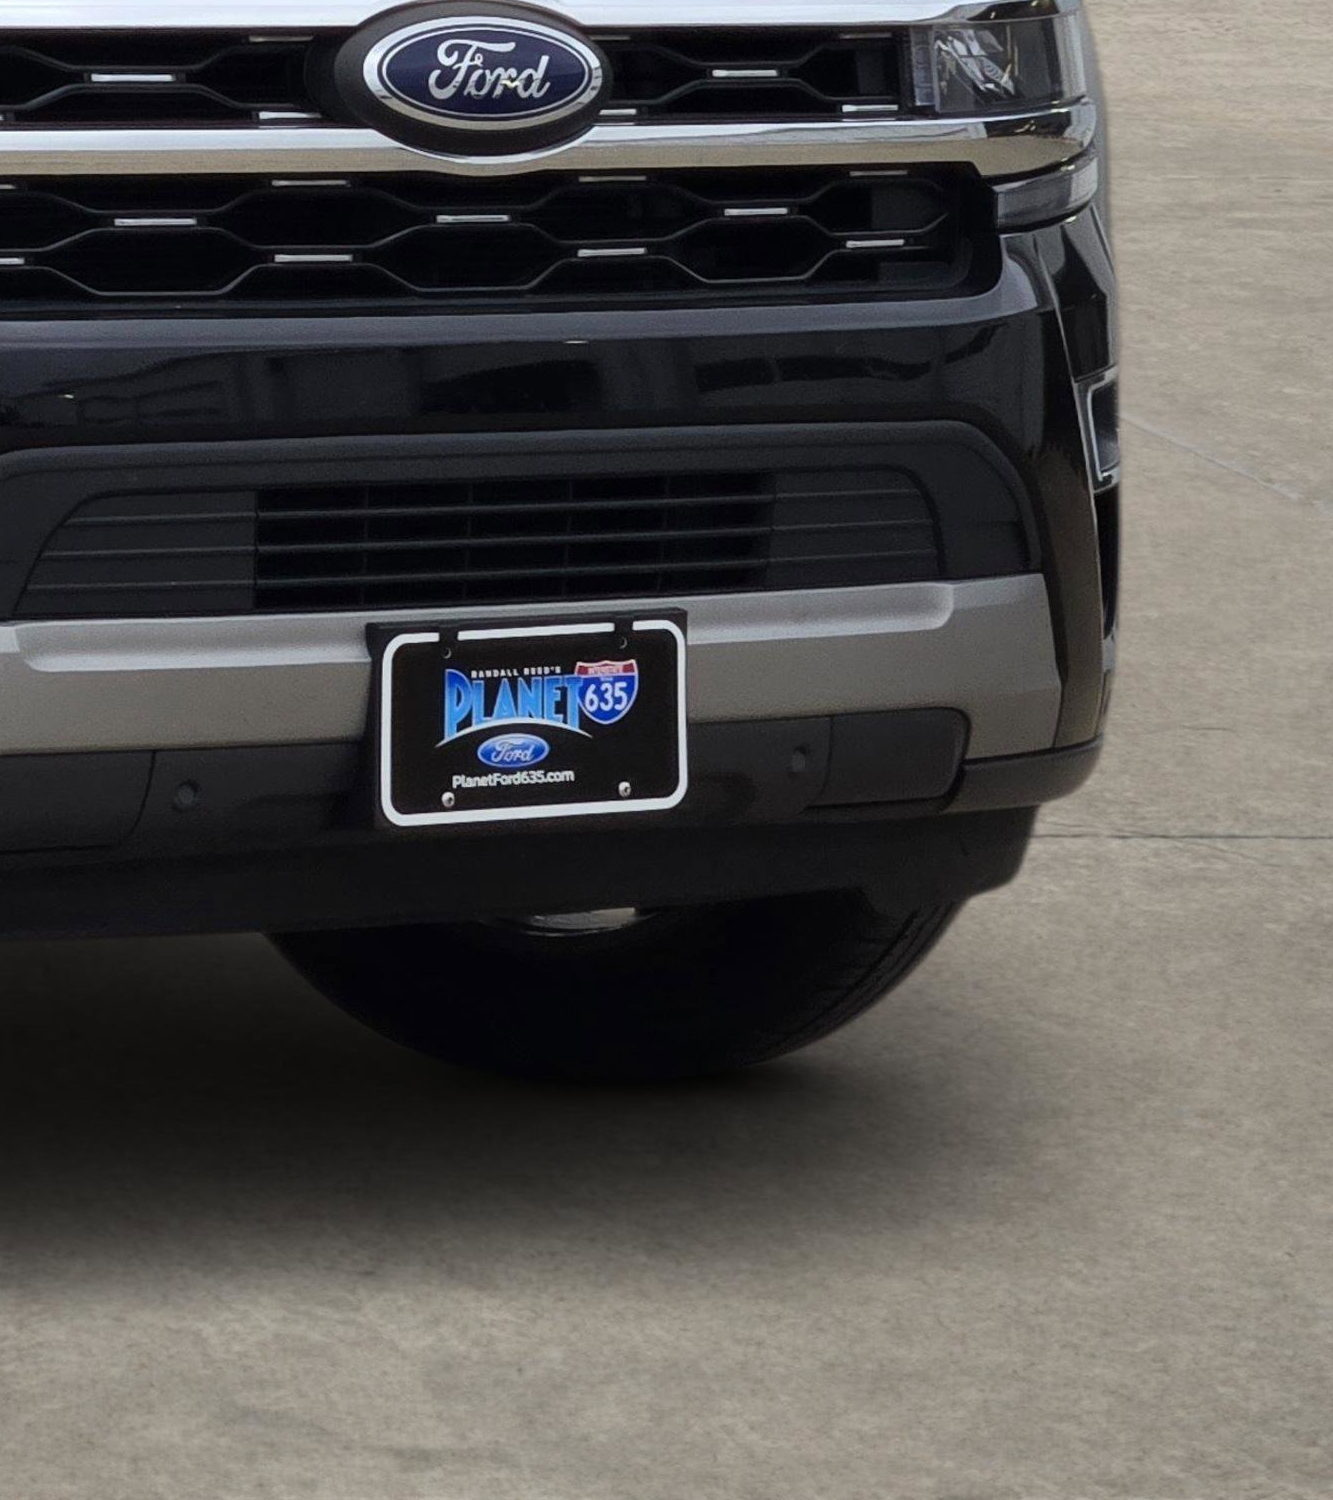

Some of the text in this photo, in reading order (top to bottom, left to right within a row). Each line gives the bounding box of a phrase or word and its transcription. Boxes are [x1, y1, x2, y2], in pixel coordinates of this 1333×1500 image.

[427, 37, 552, 100] Ford
[470, 668, 520, 679] RANDALL
[444, 668, 582, 740] PLANET
[584, 681, 628, 713] 635
[490, 739, 536, 763] Ford
[451, 769, 576, 790] PlanetFord635.com
